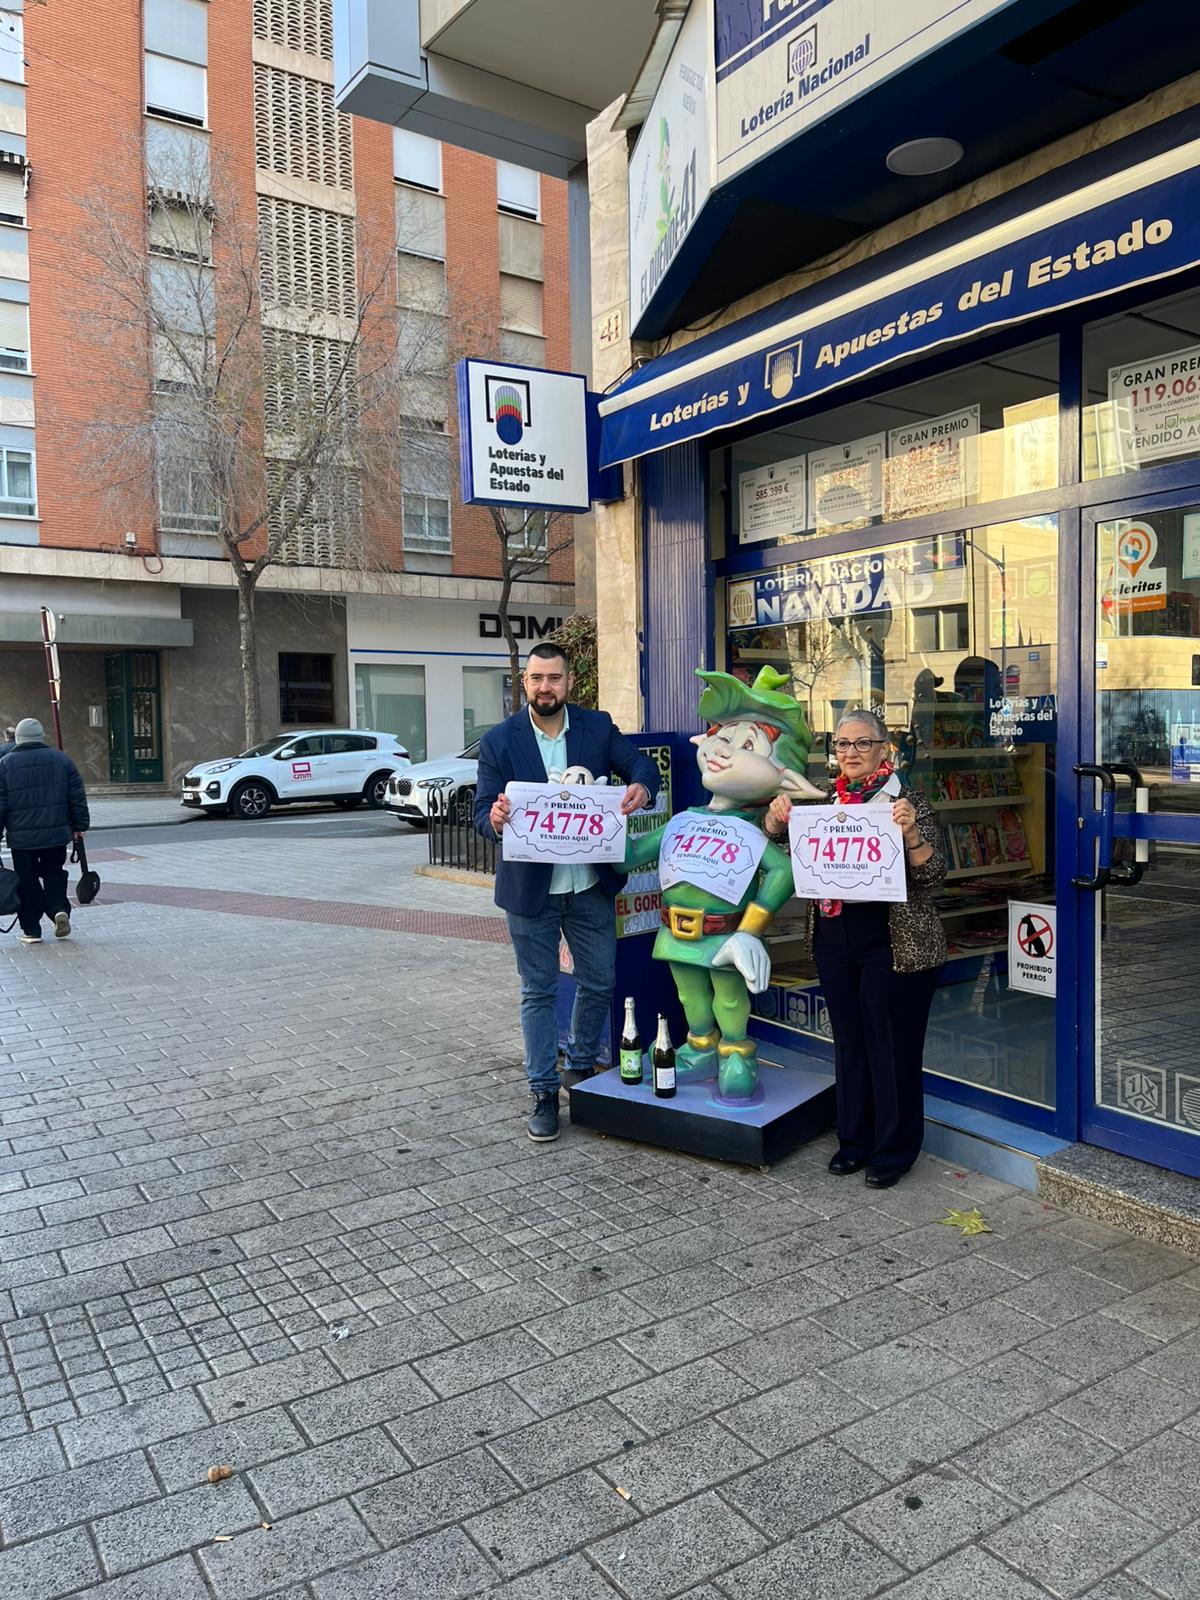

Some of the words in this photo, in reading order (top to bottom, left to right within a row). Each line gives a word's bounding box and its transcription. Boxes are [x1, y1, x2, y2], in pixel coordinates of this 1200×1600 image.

[740, 87, 794, 139] Lotería
[798, 33, 871, 101] Nacional
[600, 314, 622, 343] 41
[650, 389, 730, 432] Loterías
[737, 381, 750, 405] y
[815, 301, 944, 370] Apuestas
[957, 268, 1014, 312] del
[1027, 218, 1173, 289] Estado
[1123, 365, 1166, 387] GRAN
[1132, 374, 1200, 407] 119.06
[900, 429, 928, 446] GRAN
[931, 418, 969, 438] PREMIO
[1126, 429, 1183, 450] VENDIDO
[488, 446, 537, 463] Loterías
[539, 453, 547, 467] y
[490, 462, 544, 479] Apuestas
[547, 468, 564, 480] del
[490, 477, 531, 493] Estado
[826, 555, 921, 584] NACIONAL
[756, 576, 934, 625] NAVIDAD
[989, 696, 1030, 709] Loterías
[1031, 698, 1038, 709] y
[990, 711, 1036, 723] Apuestas
[1036, 709, 1053, 721] del
[989, 725, 1023, 737] Estado
[550, 802, 586, 810] PREMIO
[525, 810, 604, 836] 74778
[696, 826, 728, 837] PREMIO
[829, 825, 862, 833] PREMIO
[540, 833, 570, 841] VENDIDO
[672, 834, 740, 864] 74778
[808, 836, 882, 863] 74778
[616, 898, 631, 916] EL
[1017, 961, 1053, 975] PROHIBIDO
[1022, 972, 1047, 982] PERROS
